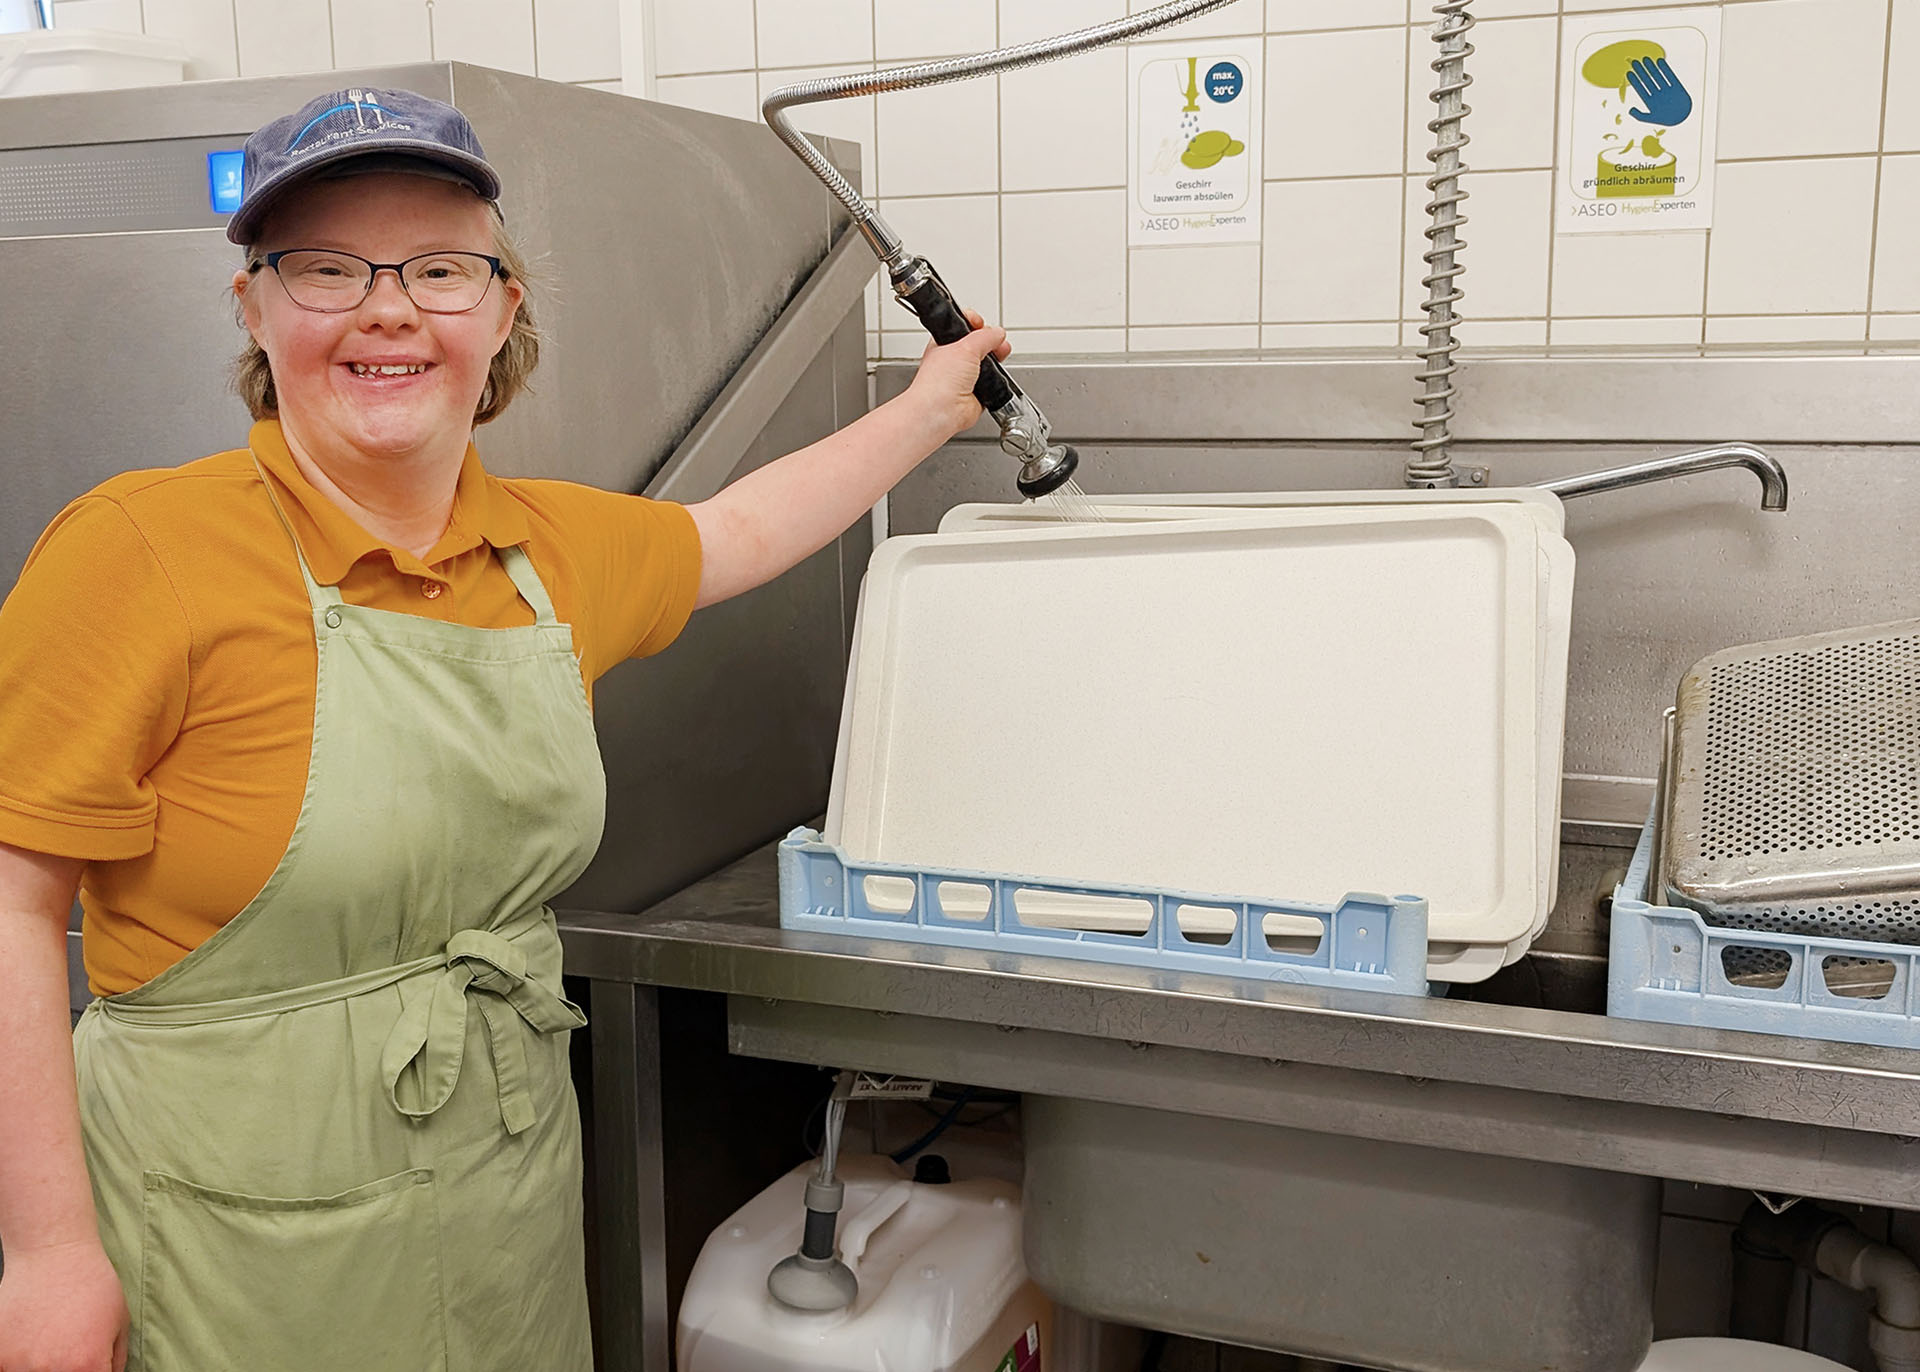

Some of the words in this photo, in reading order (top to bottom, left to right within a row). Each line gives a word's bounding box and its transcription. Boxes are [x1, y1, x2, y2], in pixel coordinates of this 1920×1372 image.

[1212, 71, 1235, 81] max.
[1213, 86, 1235, 96] 20°C
[290, 128, 354, 157] Restaurant
[356, 121, 411, 135] Services
[1614, 162, 1657, 172] Geschirr
[1175, 180, 1212, 189] Geschirr
[1583, 176, 1630, 188] gründlich
[1632, 175, 1685, 185] abräumen
[1153, 193, 1192, 202] lauwarm
[1193, 192, 1234, 202] abspülen
